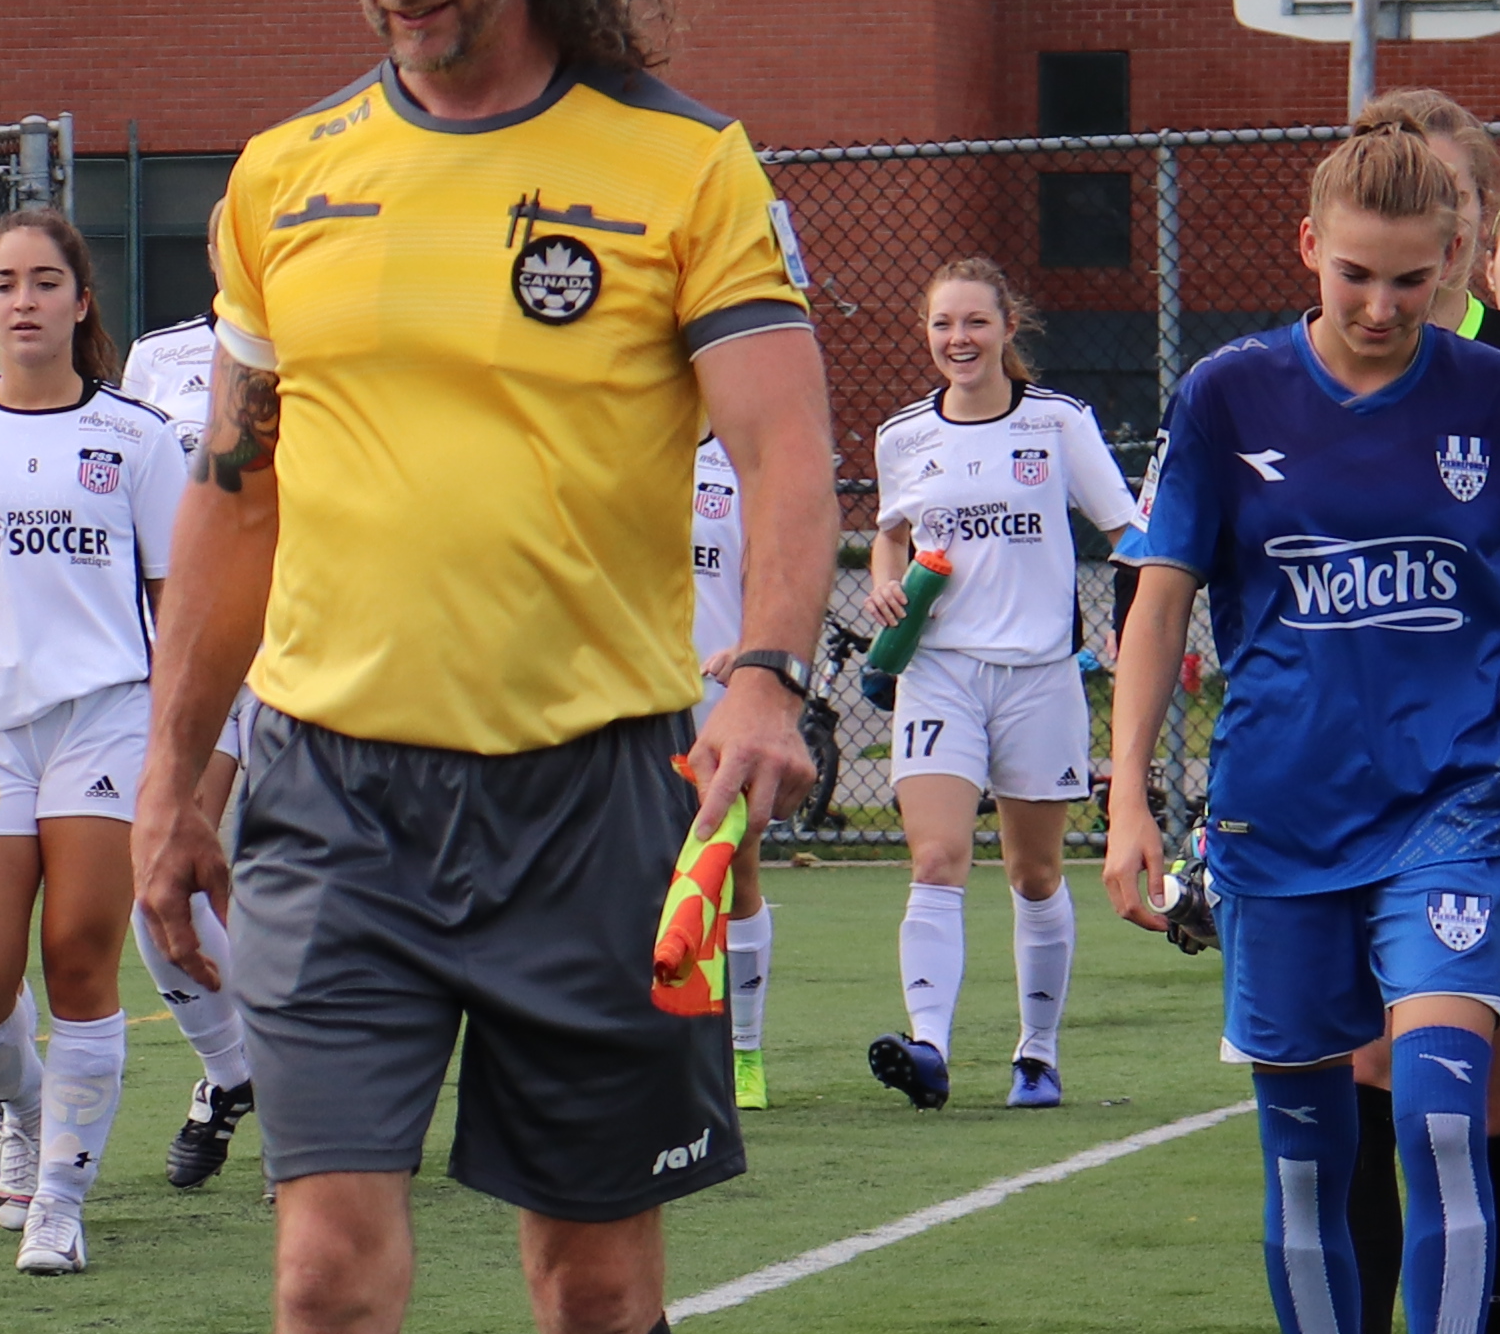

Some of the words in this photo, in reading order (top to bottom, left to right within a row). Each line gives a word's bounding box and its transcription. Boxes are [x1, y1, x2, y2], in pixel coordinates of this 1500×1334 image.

[309, 97, 371, 141] savi
[519, 273, 593, 290] CANADA
[89, 451, 114, 462] FSS
[1019, 450, 1041, 459] FSS
[27, 457, 37, 473] 8
[967, 461, 982, 477] 17
[7, 509, 72, 525] PASSION
[957, 502, 1008, 518] PASSION
[960, 512, 1042, 541] SOCCER
[9, 527, 111, 556] SOCCER
[70, 555, 112, 568] Boutique
[1279, 549, 1458, 616] Welch's
[905, 720, 944, 759] 17
[84, 789, 120, 799] adidas
[652, 1127, 710, 1176] savi
